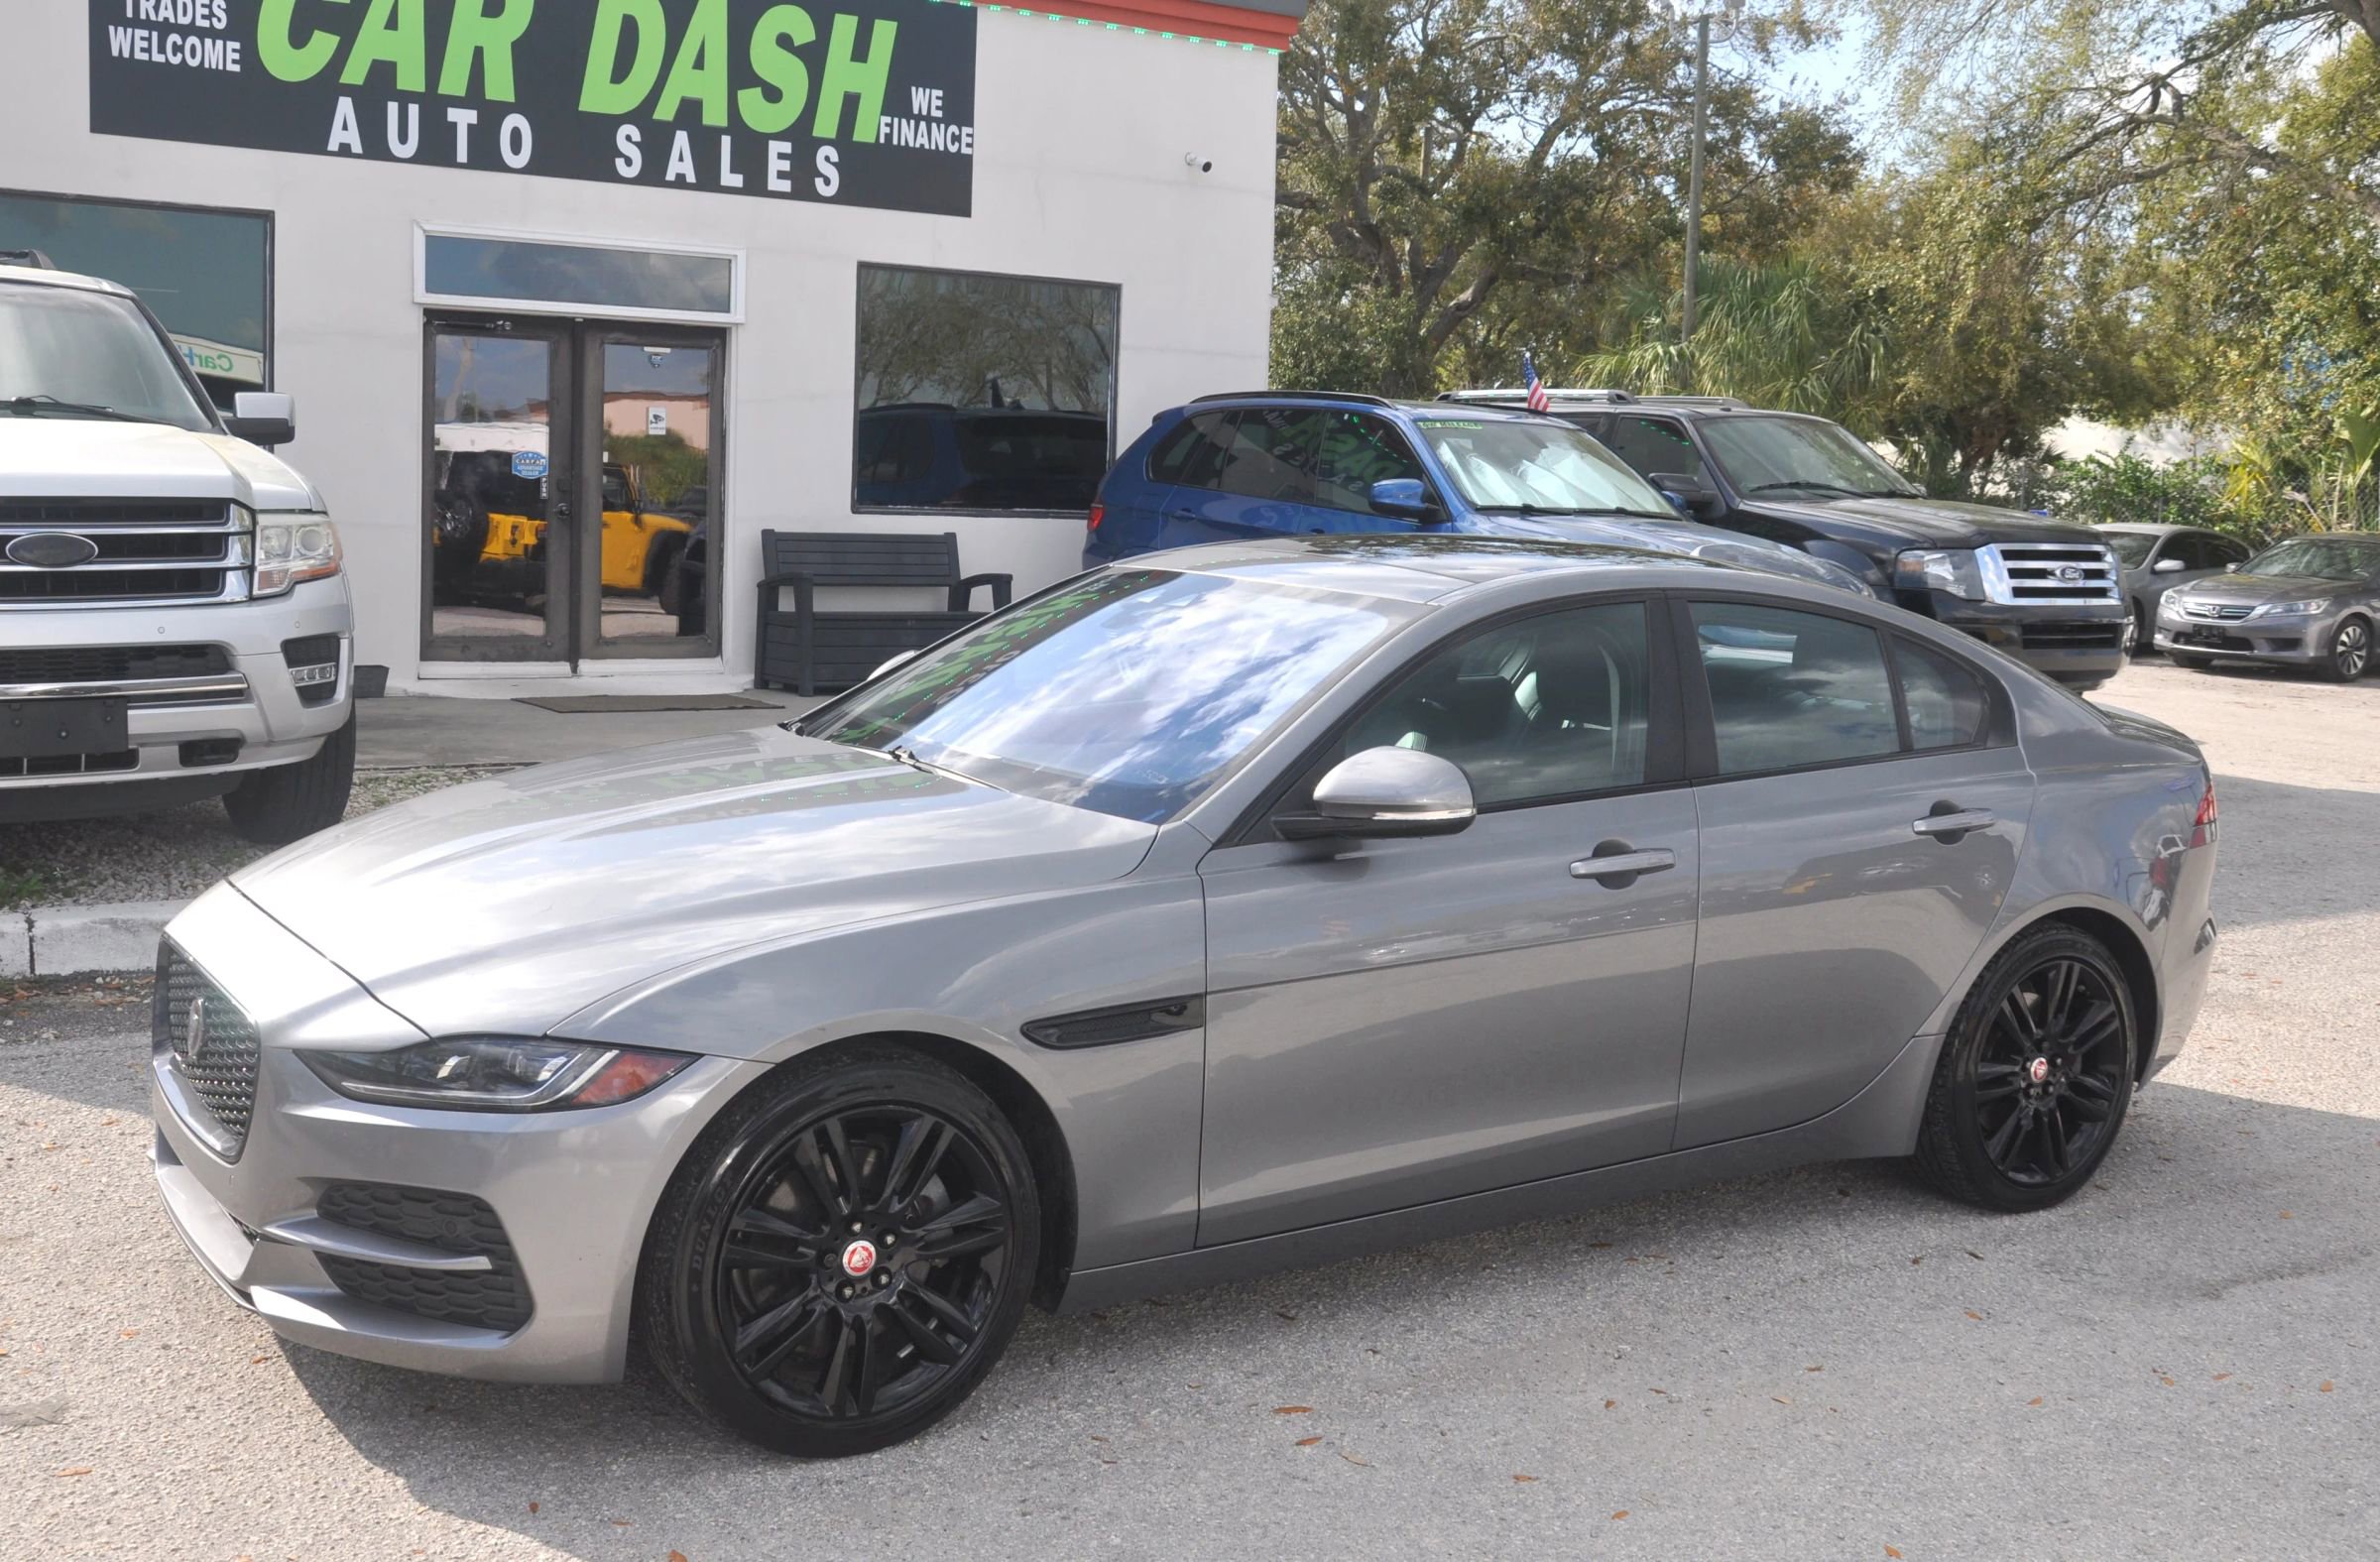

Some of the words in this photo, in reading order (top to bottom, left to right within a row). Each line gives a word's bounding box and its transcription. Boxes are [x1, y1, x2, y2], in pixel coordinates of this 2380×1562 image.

[108, 25, 241, 72] WELCOME
[257, 0, 535, 102] CAR
[578, 0, 898, 143] DASH
[911, 85, 943, 118] WE
[327, 96, 533, 169] AUTO
[615, 124, 840, 197] SALES
[879, 115, 974, 155] FINANCE
